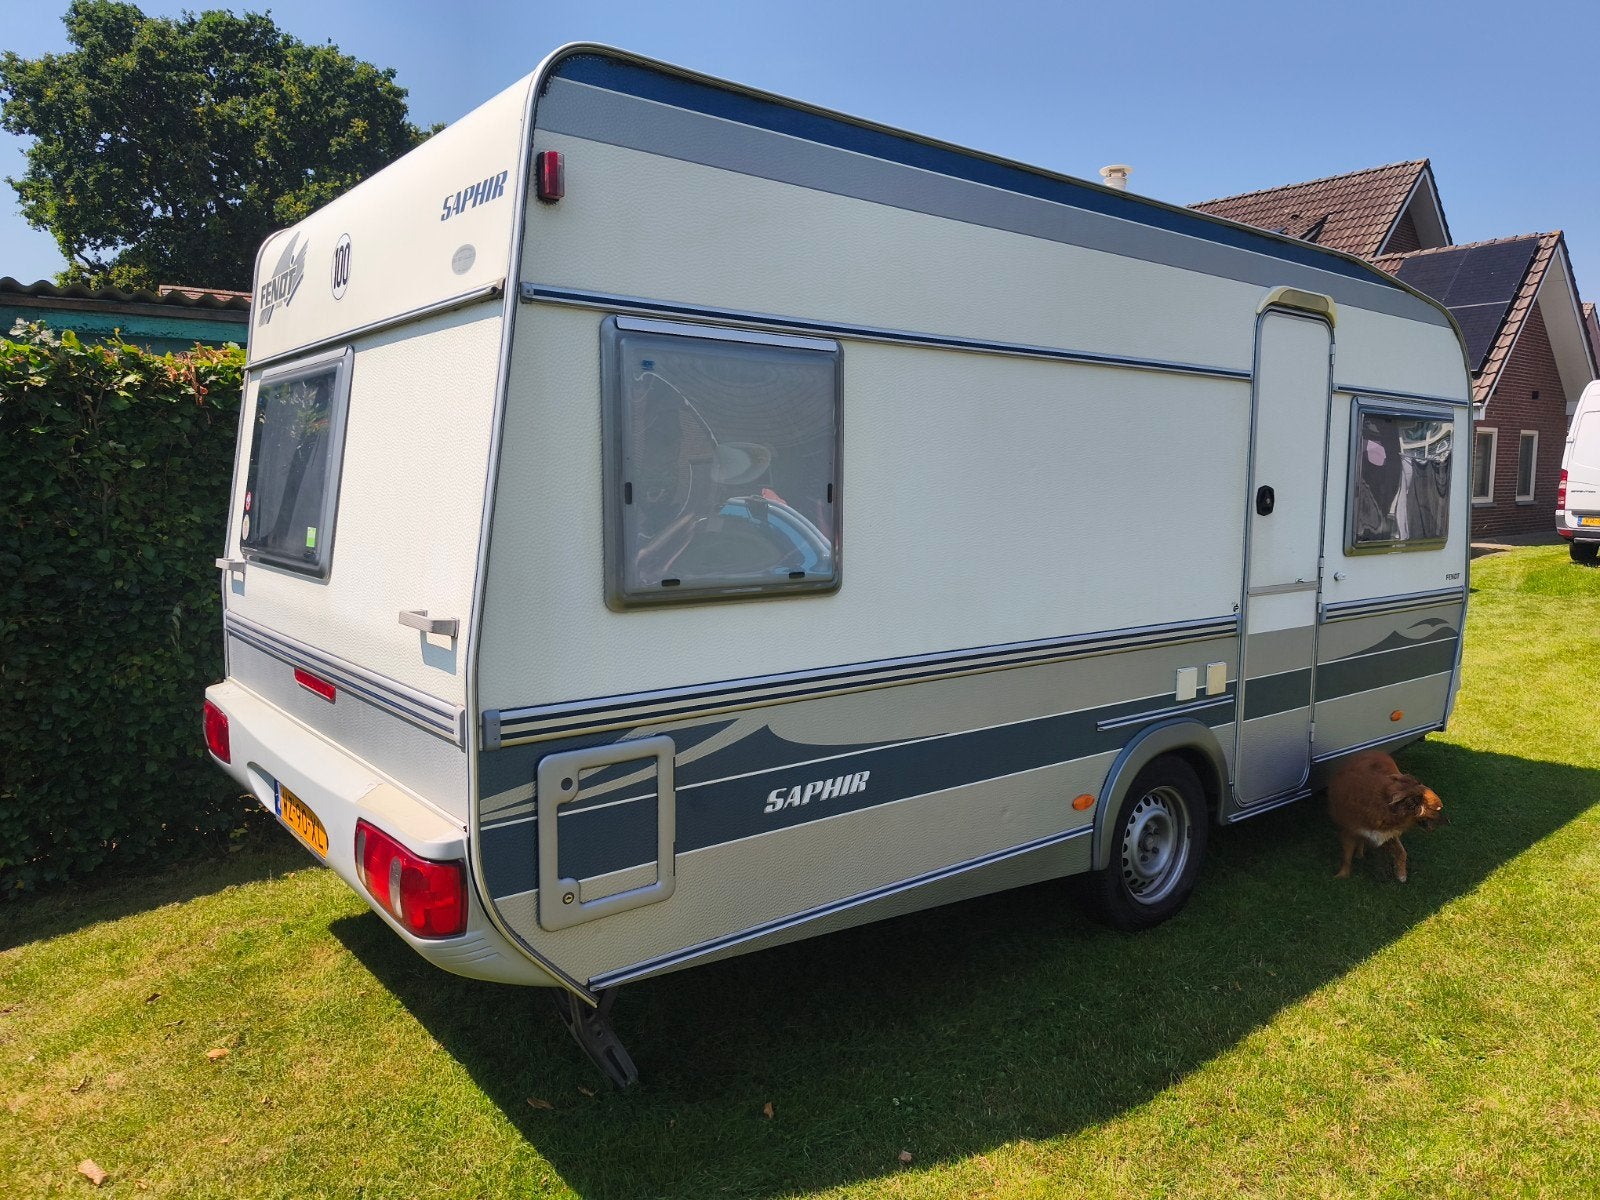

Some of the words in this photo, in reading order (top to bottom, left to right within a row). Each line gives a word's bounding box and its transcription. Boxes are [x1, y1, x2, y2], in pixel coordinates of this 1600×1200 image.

[441, 170, 508, 221] SAPHIR
[261, 267, 297, 309] FENDT
[333, 242, 350, 289] 100
[763, 770, 871, 814] SAPHIR
